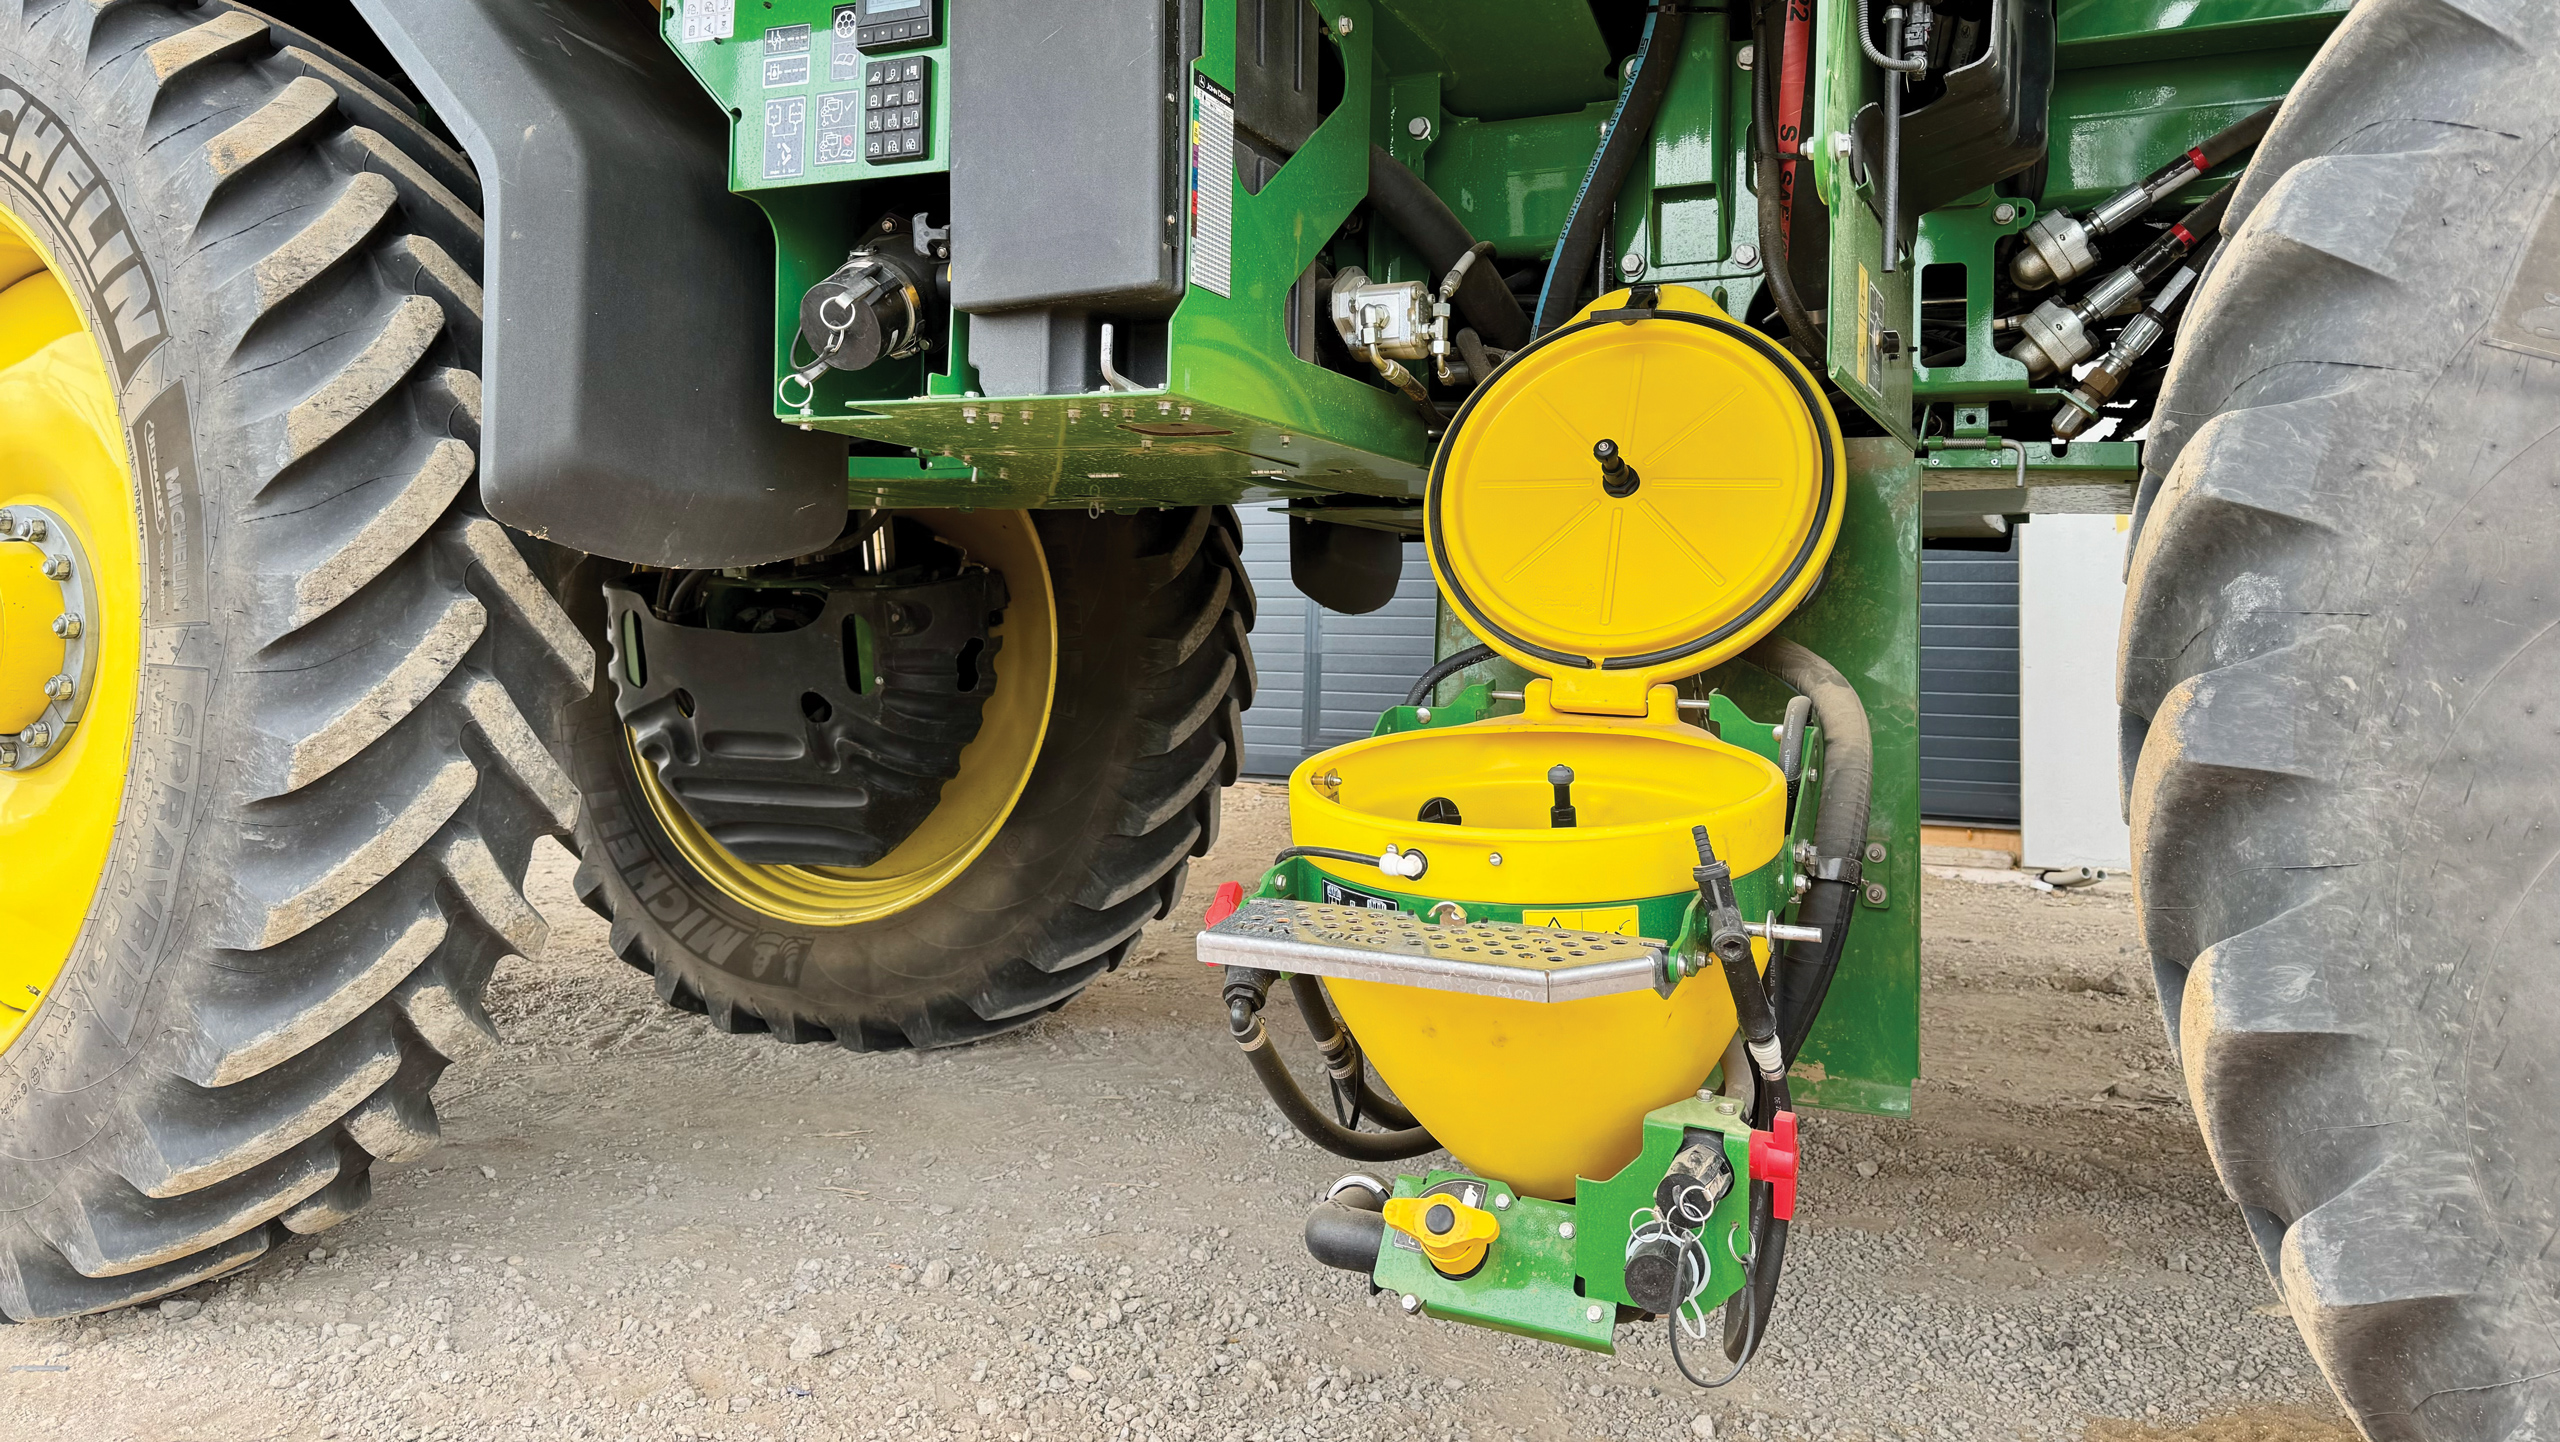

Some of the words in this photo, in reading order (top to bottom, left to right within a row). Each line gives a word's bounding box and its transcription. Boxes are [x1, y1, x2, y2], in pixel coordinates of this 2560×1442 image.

[164, 466, 188, 610] MICHELIN
[107, 700, 195, 1009] SPRAYBIB
[578, 772, 750, 966] MICHELI
